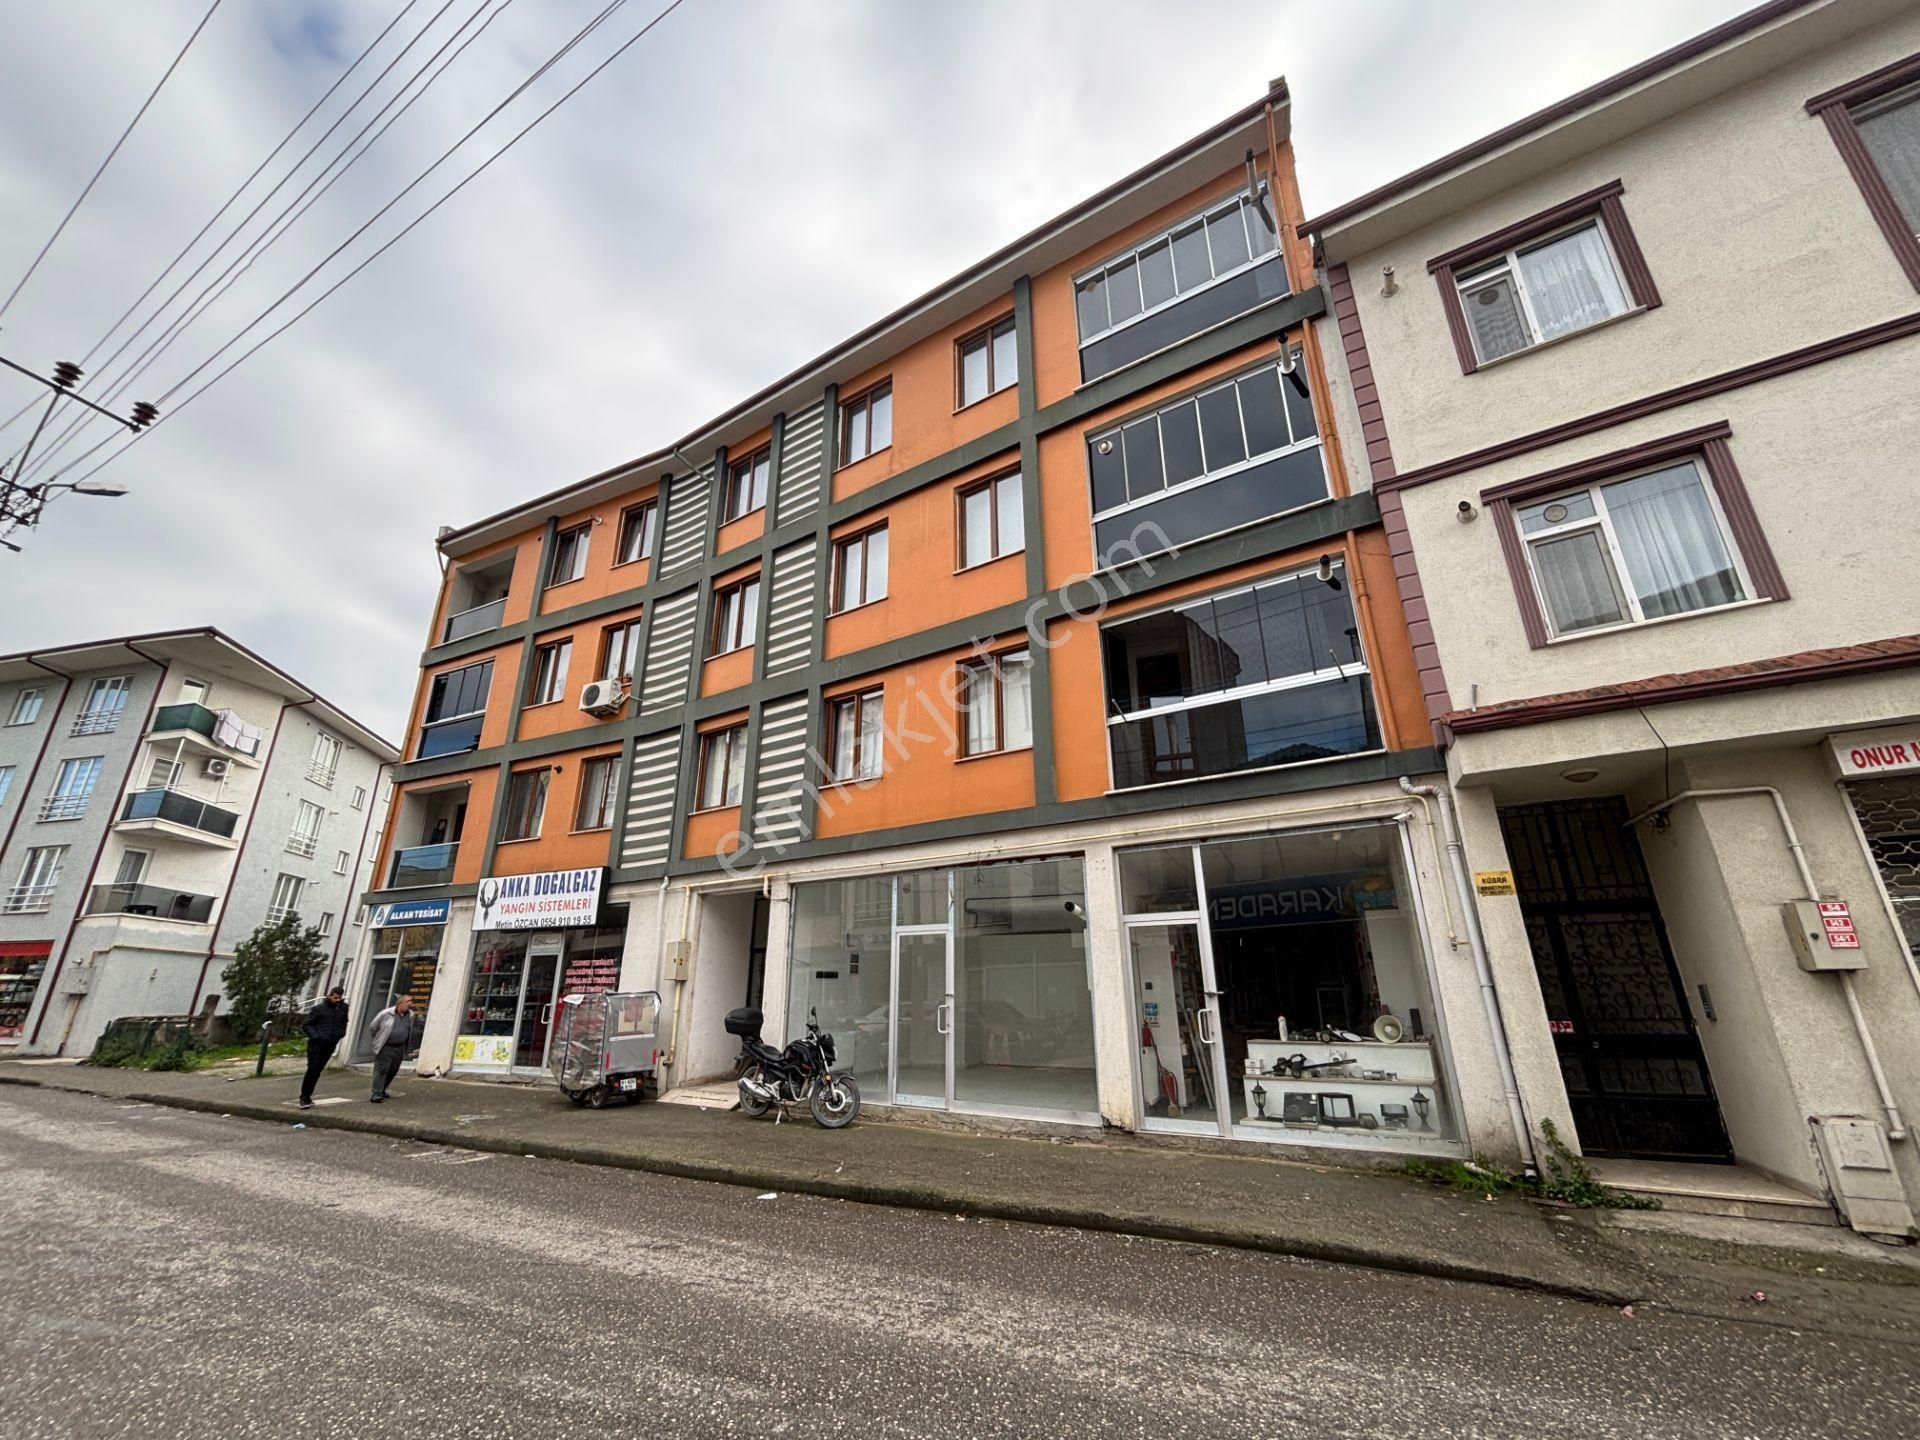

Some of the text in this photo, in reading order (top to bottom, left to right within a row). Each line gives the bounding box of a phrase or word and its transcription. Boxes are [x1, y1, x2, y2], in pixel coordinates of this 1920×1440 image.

[1851, 744, 1911, 769] ONUR
[500, 878, 530, 898] ANKA
[390, 906, 444, 920] ALKAN TESİSAT
[500, 895, 592, 915] YANGIN SİSTEMLERİ
